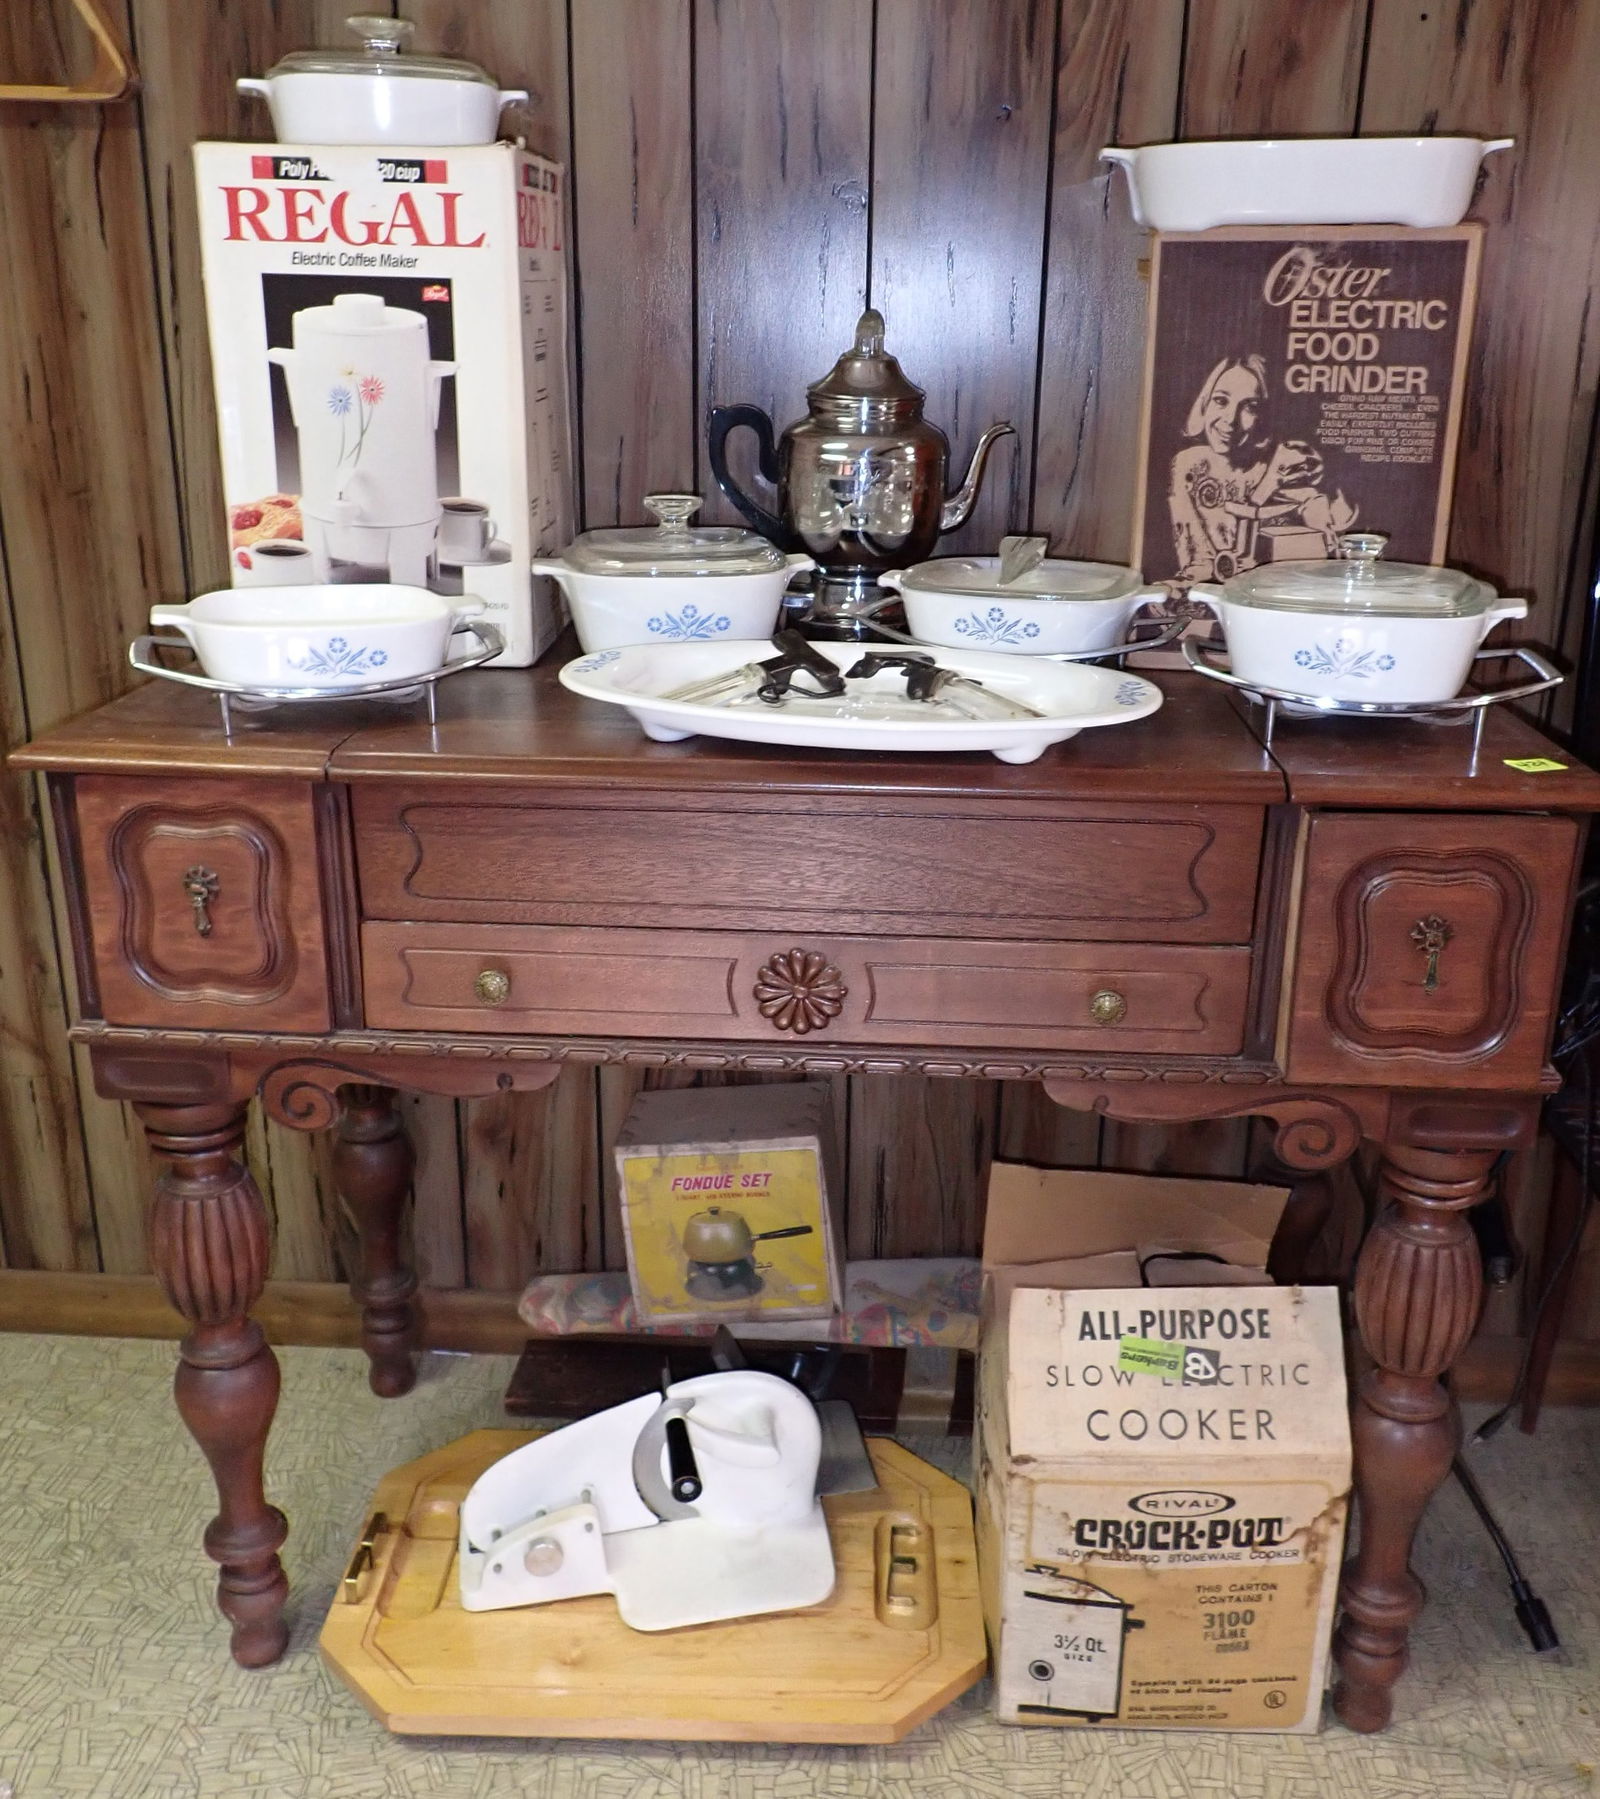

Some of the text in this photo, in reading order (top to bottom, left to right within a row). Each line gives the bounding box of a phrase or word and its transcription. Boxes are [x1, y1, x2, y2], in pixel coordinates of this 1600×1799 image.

[280, 160, 311, 180] Poly
[396, 167, 420, 183] cup
[218, 186, 486, 248] REGAL
[292, 251, 419, 269] Electric Coffee Maker
[1264, 247, 1392, 306] Oster
[1290, 299, 1448, 330] ELECTRIC
[1286, 331, 1380, 361] FOOD
[1284, 364, 1429, 394] GRINDER
[671, 1172, 773, 1192] FONDUE SET
[1078, 1308, 1271, 1341] ALL-PURPOSE
[1046, 1364, 1136, 1387] SLOW
[1086, 1409, 1277, 1442] COOKER
[1146, 1499, 1216, 1509] RIVAL
[1168, 1551, 1242, 1563] STONEWARE
[1249, 1549, 1299, 1560] COOKER
[1196, 1582, 1278, 1593] THIS CARTON
[1198, 1594, 1263, 1604] CONTAINS
[1203, 1609, 1255, 1629] 3100
[1203, 1628, 1247, 1641] FLAME
[1064, 1653, 1092, 1662] SIZE
